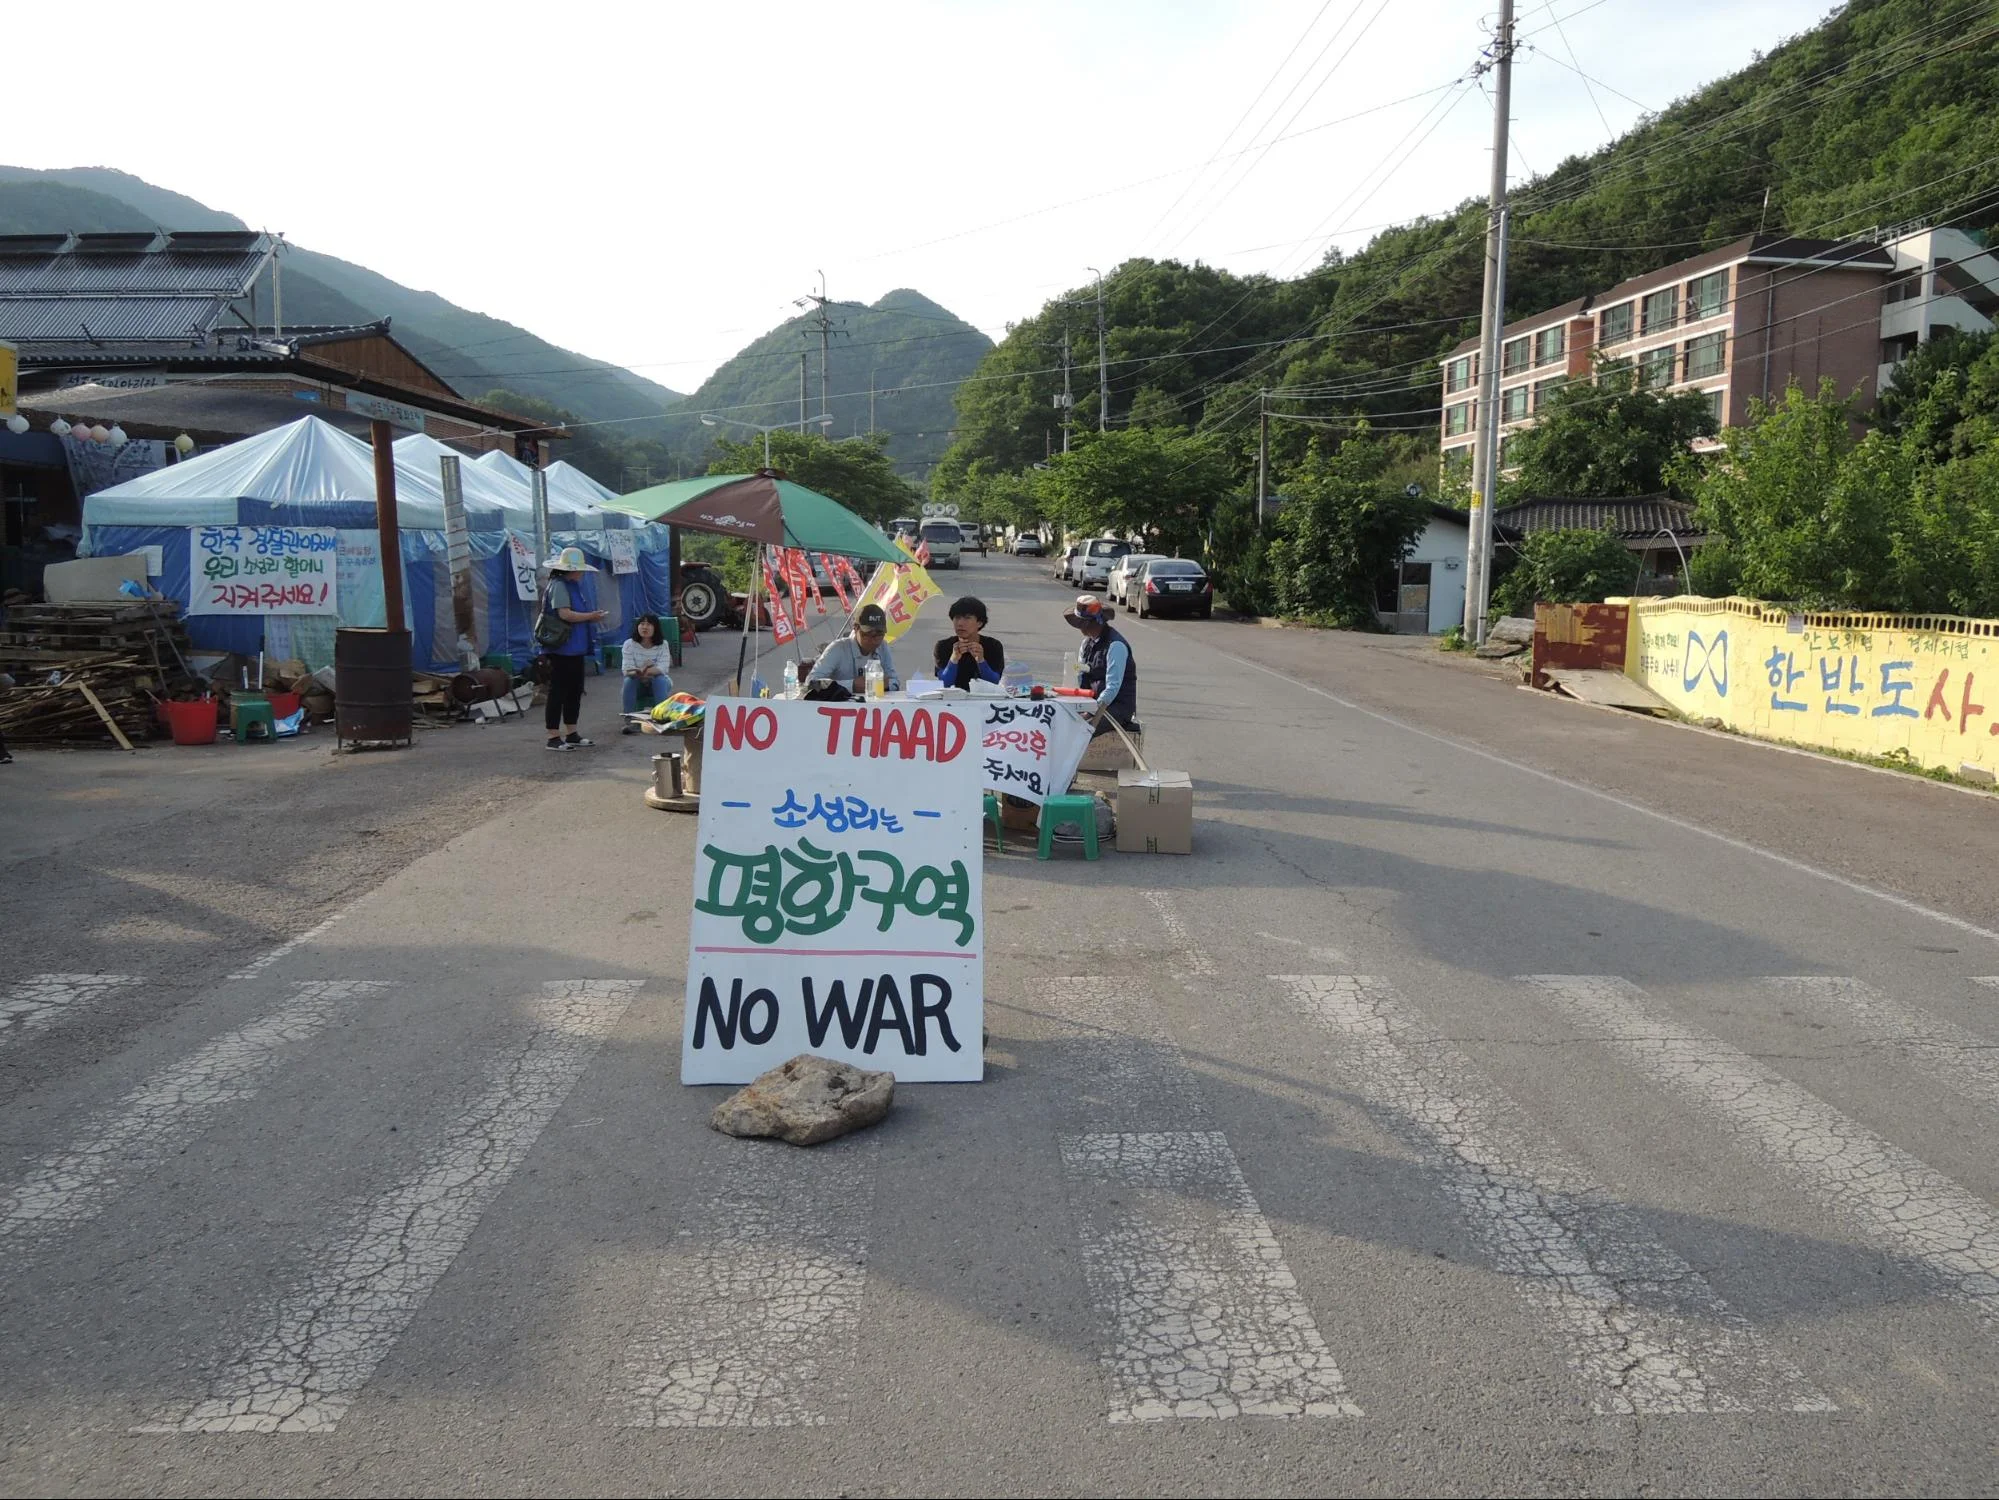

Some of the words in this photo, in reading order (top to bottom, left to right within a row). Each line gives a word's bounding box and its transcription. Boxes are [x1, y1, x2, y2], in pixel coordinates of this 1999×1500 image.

[200, 526, 242, 556] 한국
[203, 556, 239, 581] 우리
[244, 556, 280, 576] 소성리
[284, 556, 324, 579] 할머니
[212, 582, 329, 609] 지켜주세요!
[1803, 631, 1873, 653] 안보위협
[1907, 637, 1969, 660] 경제위협
[1765, 645, 1919, 720] 한반도
[712, 704, 778, 751] NO
[817, 706, 967, 763] THAAD
[772, 788, 905, 834] 소성리는
[694, 836, 975, 947] 평화구역
[692, 976, 780, 1050] NO
[802, 973, 962, 1056] WAR
